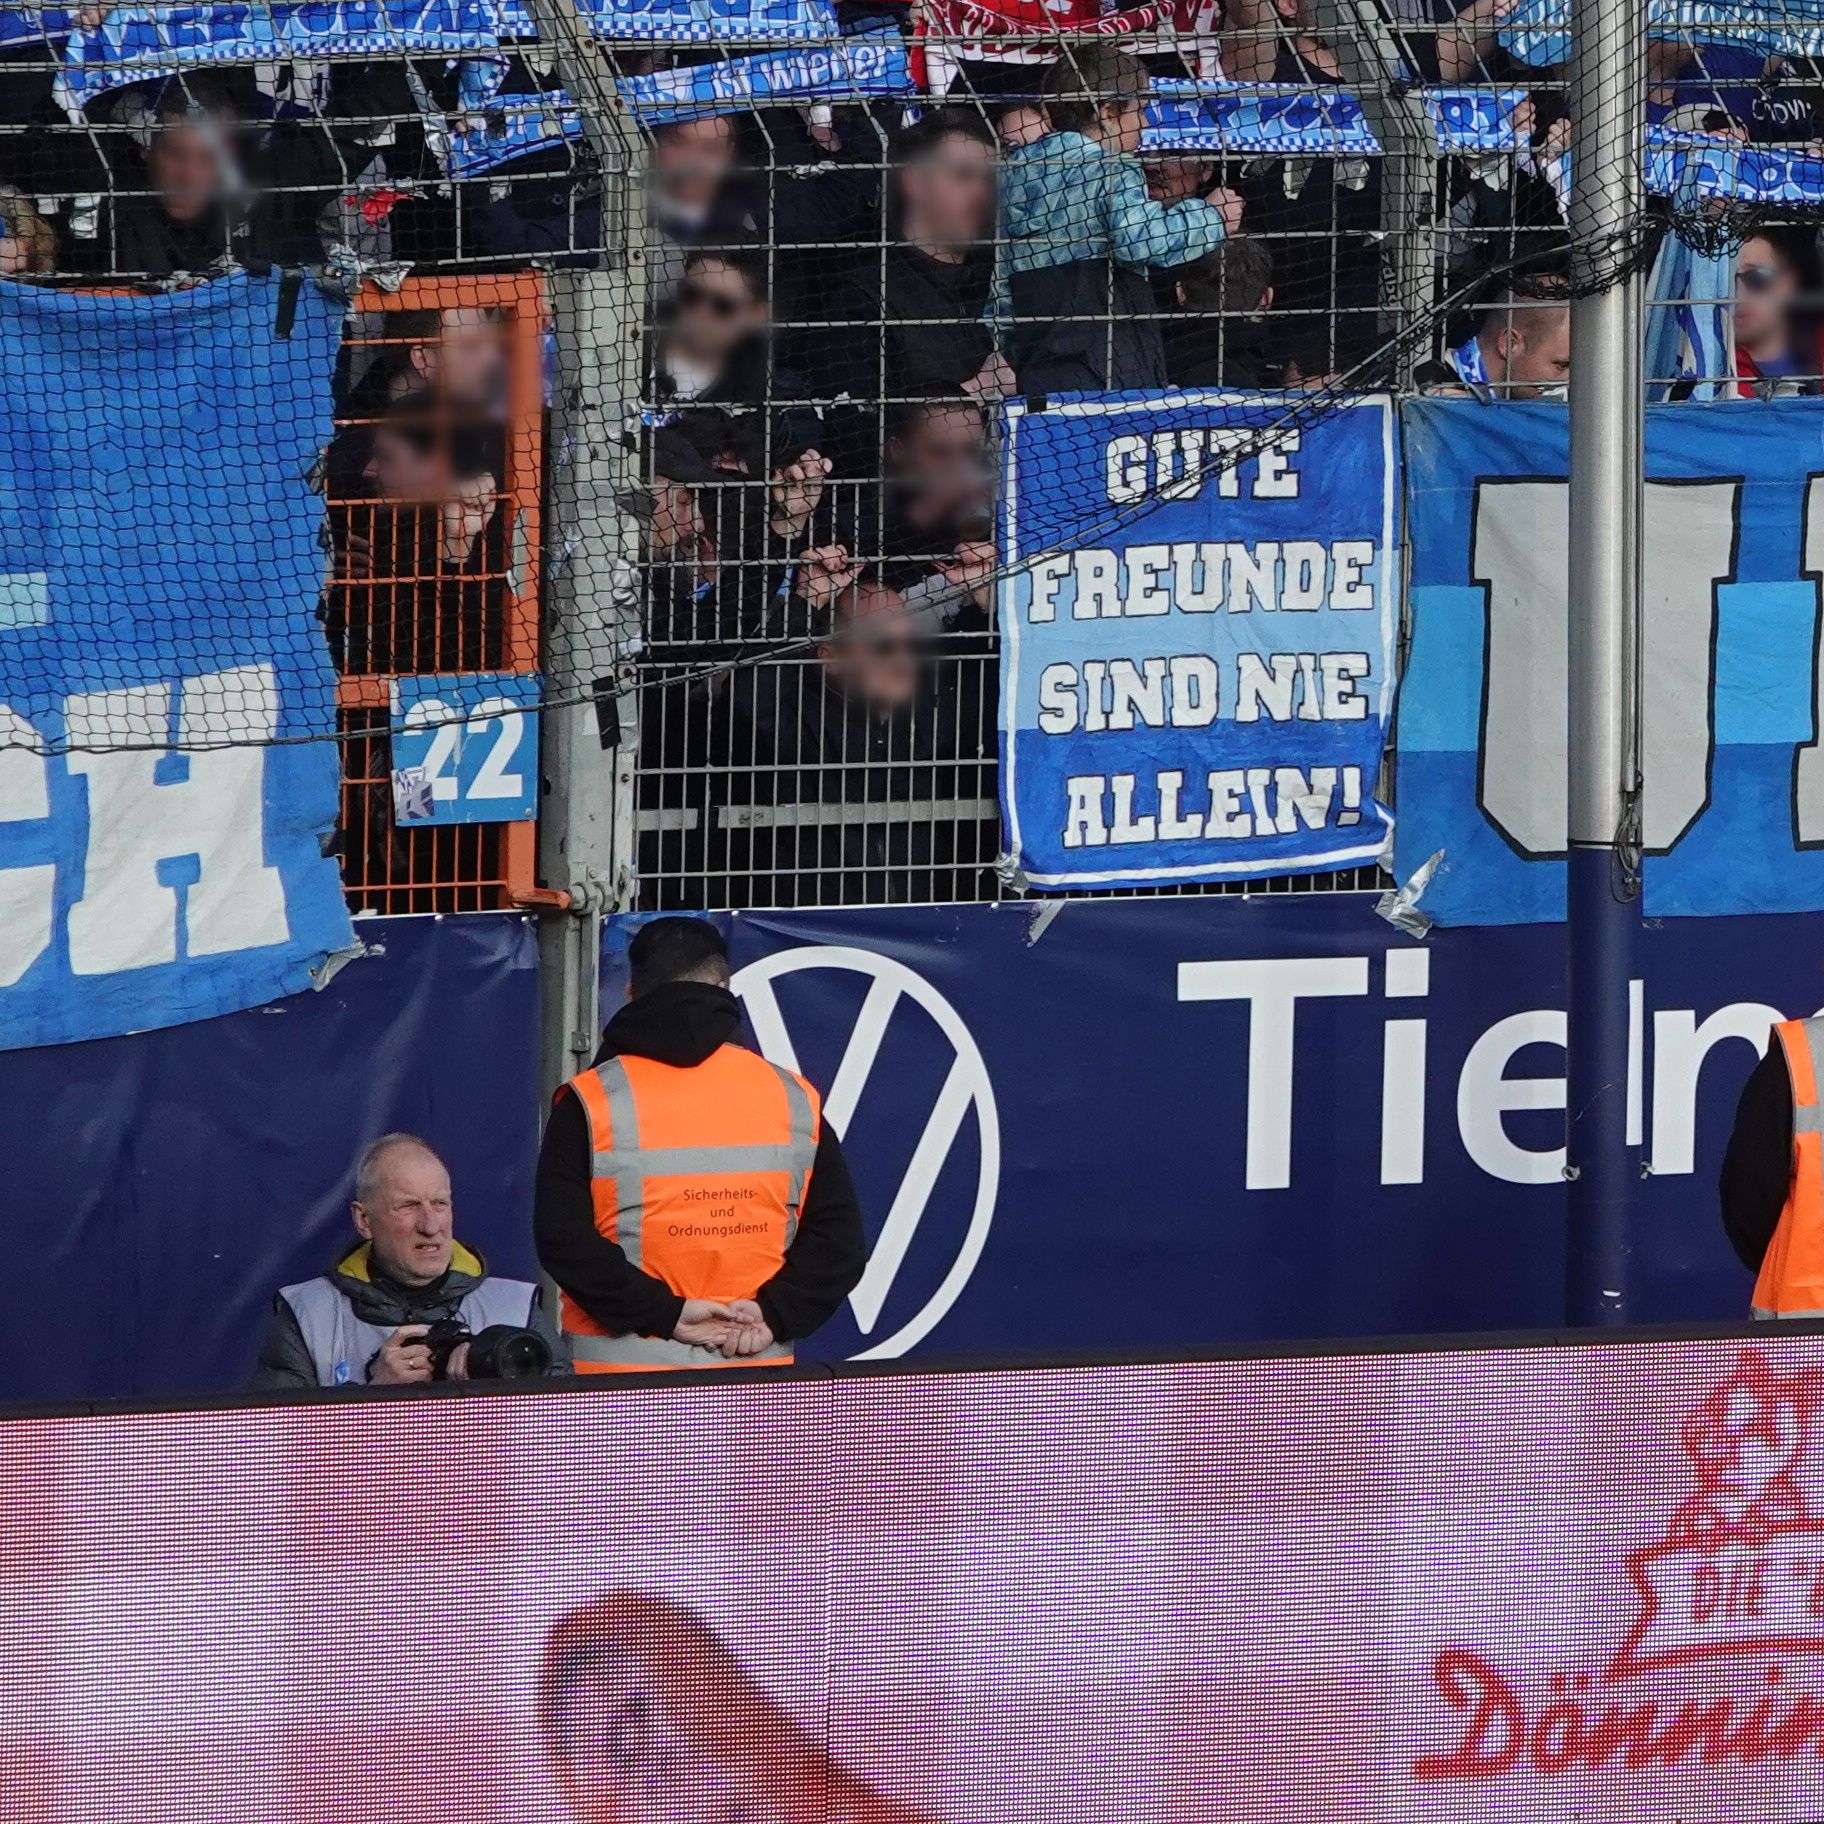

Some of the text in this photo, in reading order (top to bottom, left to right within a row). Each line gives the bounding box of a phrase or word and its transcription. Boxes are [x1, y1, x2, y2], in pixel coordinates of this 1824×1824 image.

[1104, 426, 1301, 506] GUTE
[1027, 538, 1377, 625] FREUNDE
[1037, 650, 1370, 736] SIND NIE
[402, 689, 530, 802] 22
[1062, 764, 1364, 850] ALLEIN!
[668, 1222, 769, 1238] Ordnungsdienst
[683, 1188, 759, 1202] Sicherheits-
[710, 1206, 735, 1218] und
[1688, 1563, 1771, 1623] DIE
